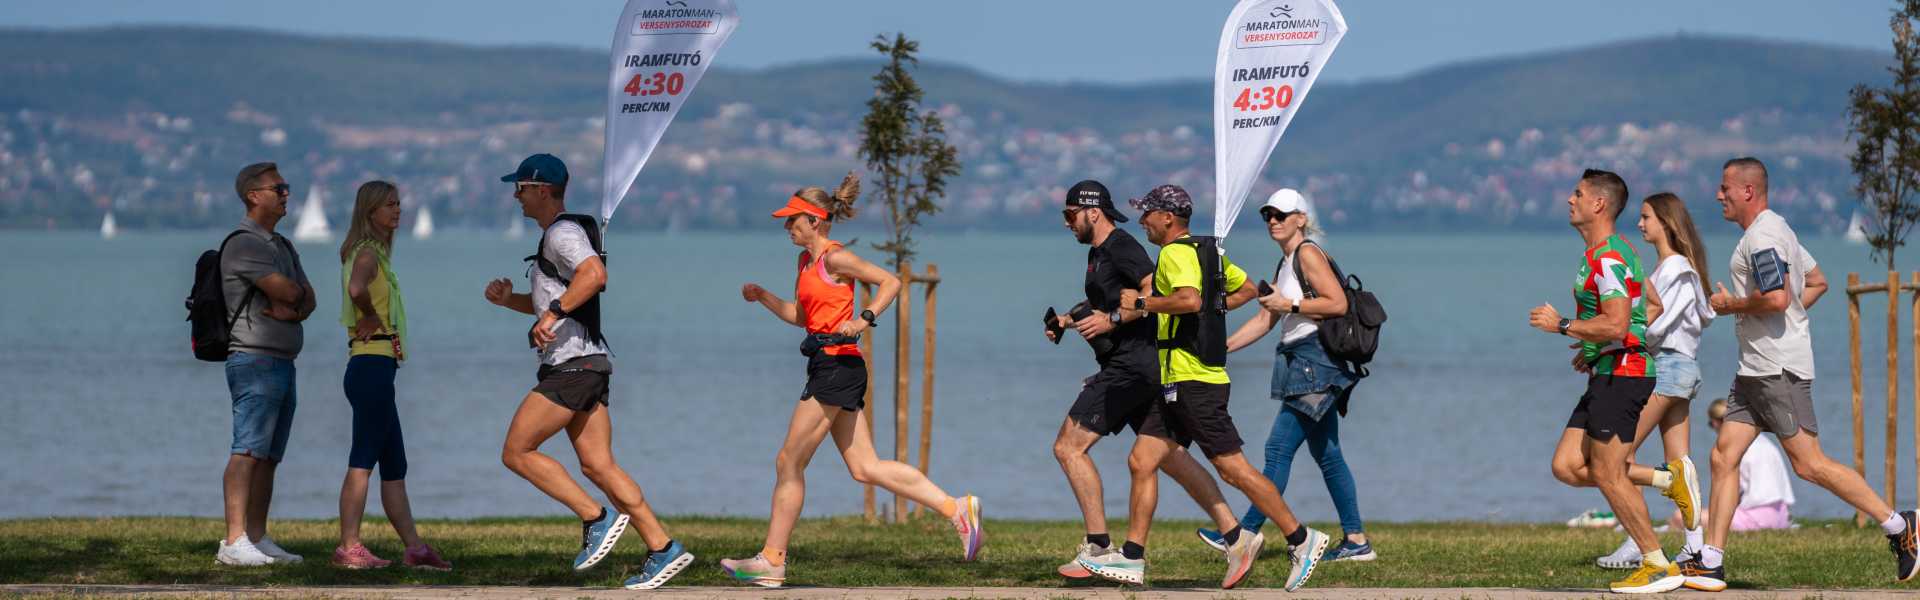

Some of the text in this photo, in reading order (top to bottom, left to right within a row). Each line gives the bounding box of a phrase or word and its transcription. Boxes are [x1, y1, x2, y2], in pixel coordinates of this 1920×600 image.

[642, 9, 715, 19] MARATONMAN
[640, 20, 712, 30] VERSENYSOROZAT
[1246, 19, 1320, 32] MARATONMAN
[1245, 31, 1318, 43] VERSENYSOROZAT
[624, 50, 701, 68] IRAMFUTÓ
[1232, 61, 1311, 82] IRAMFUTÓ
[623, 71, 685, 97] 4:30
[1232, 84, 1294, 112] 4:30
[621, 101, 671, 114] PERC/KM
[1232, 115, 1281, 129] PERC/KM
